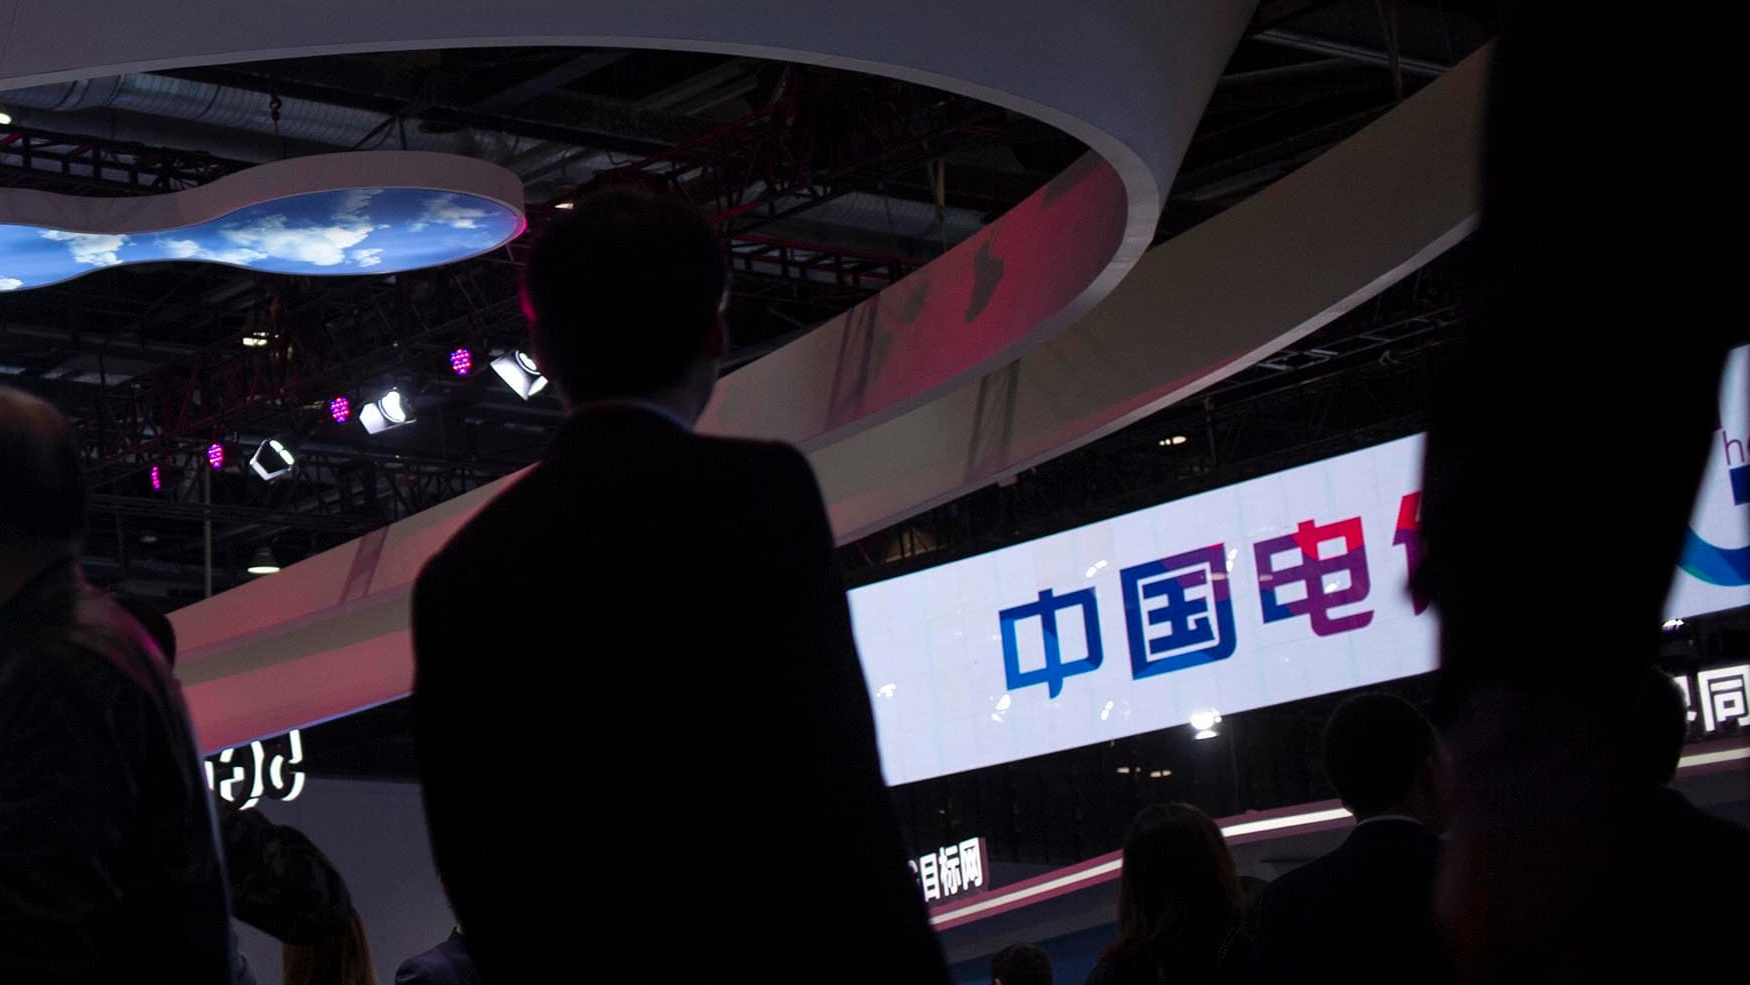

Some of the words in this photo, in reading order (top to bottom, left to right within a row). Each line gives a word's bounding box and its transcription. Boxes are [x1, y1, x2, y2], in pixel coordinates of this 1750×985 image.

[997, 491, 1432, 699] 中国电
[906, 837, 984, 903] 目标网
